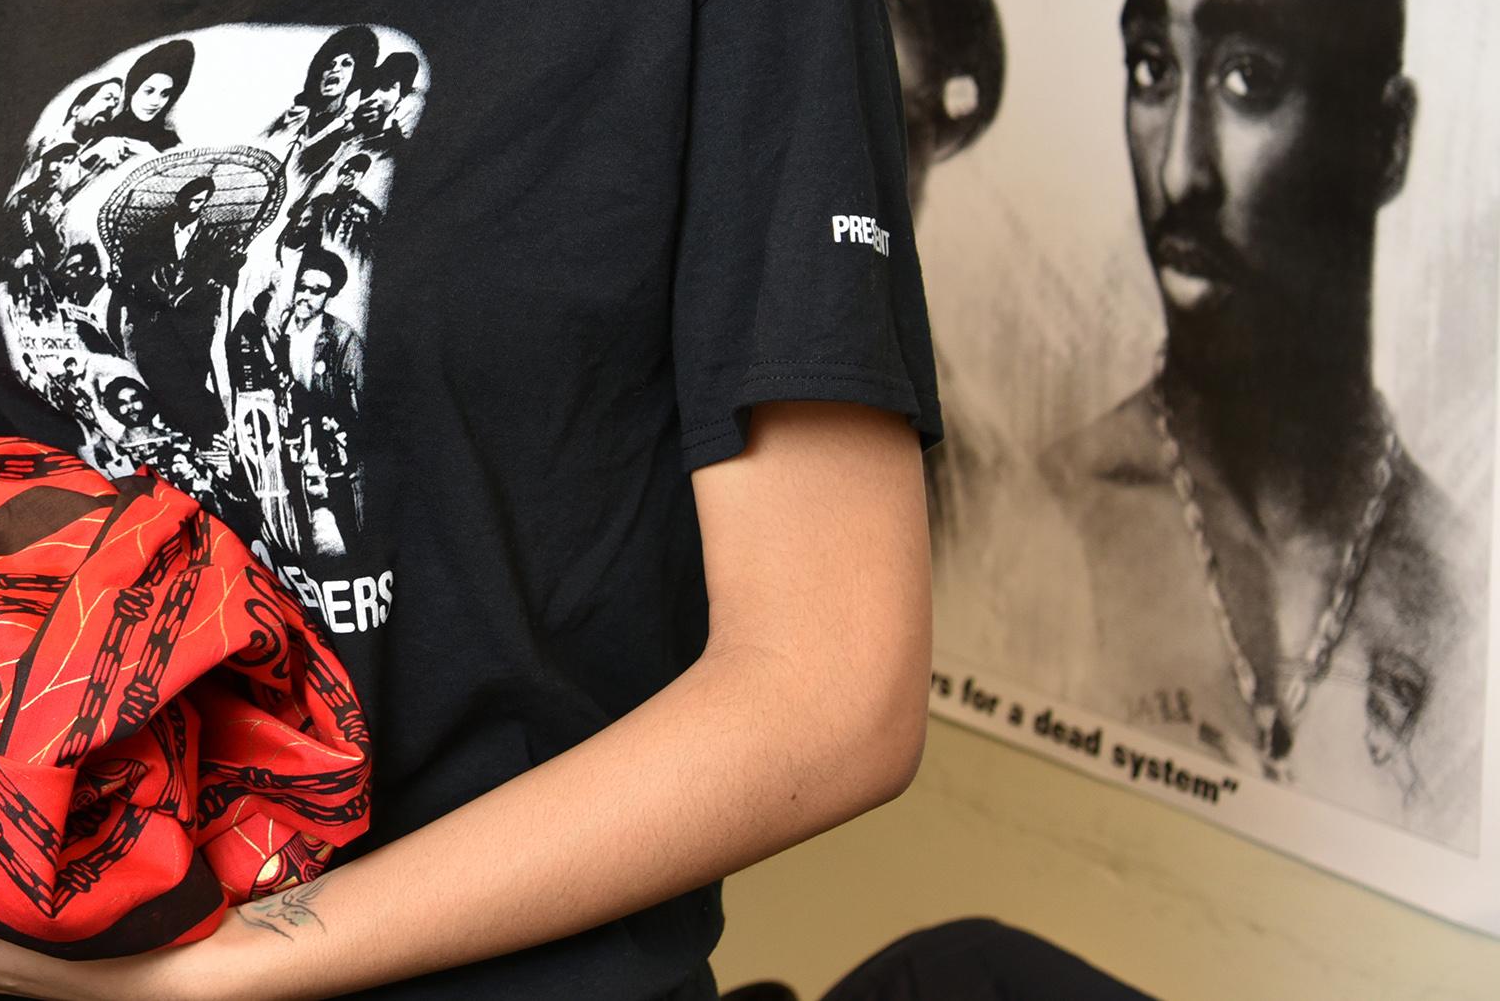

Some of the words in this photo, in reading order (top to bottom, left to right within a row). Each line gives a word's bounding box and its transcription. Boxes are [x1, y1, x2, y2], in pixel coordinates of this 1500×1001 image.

[832, 215, 890, 258] PRESENT
[962, 677, 999, 716] for
[1008, 702, 1025, 726] a
[1033, 707, 1102, 757] dead
